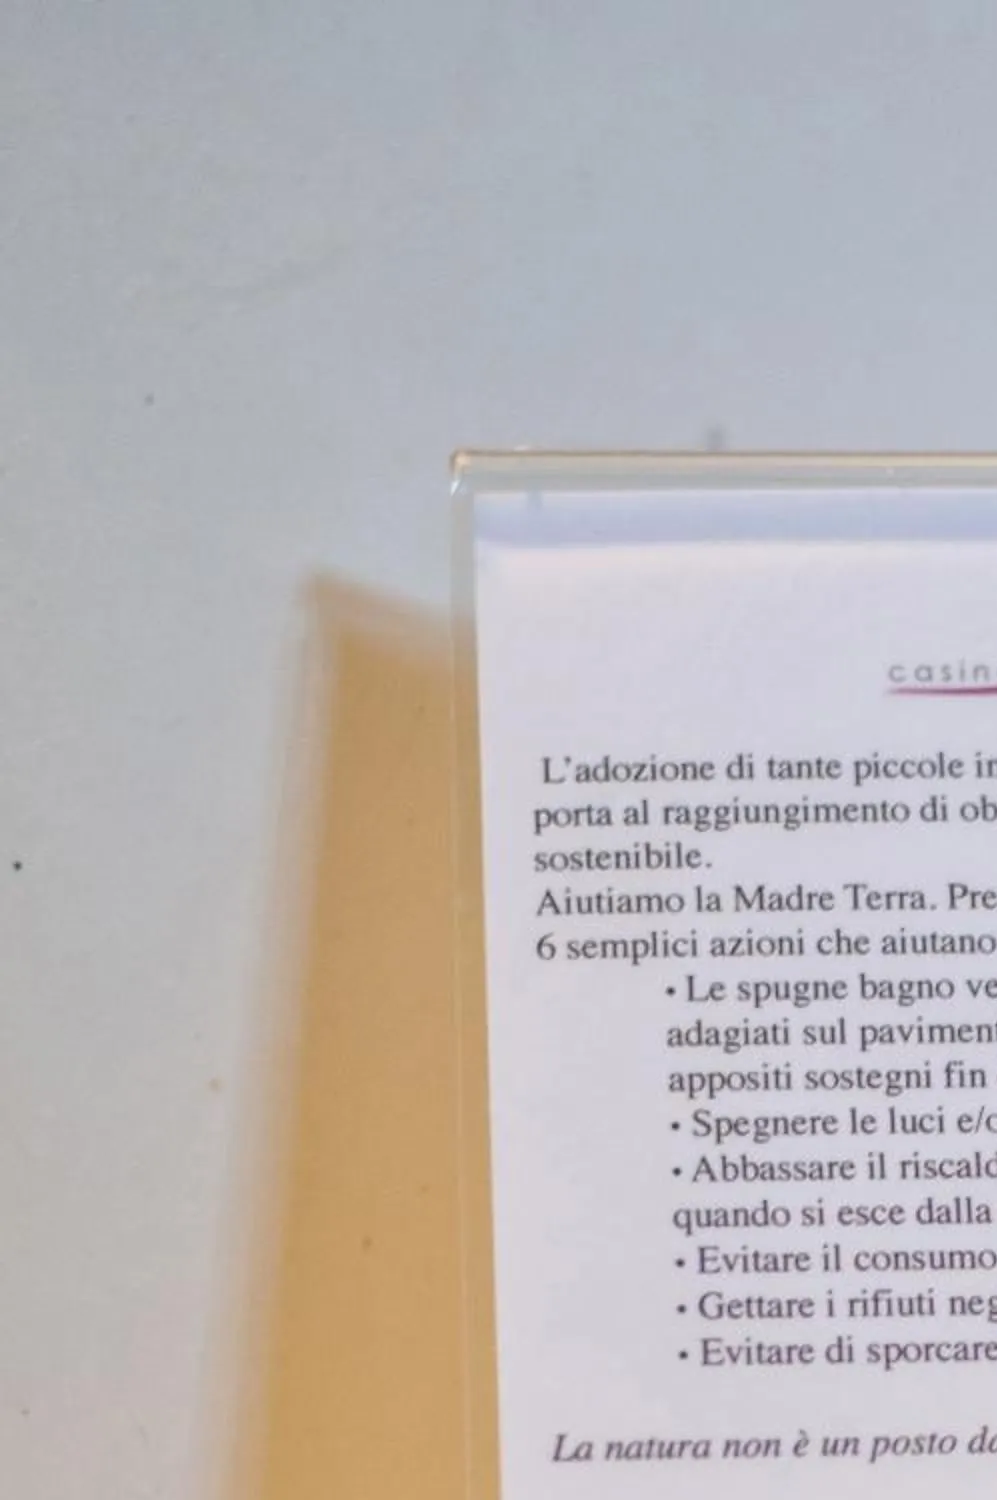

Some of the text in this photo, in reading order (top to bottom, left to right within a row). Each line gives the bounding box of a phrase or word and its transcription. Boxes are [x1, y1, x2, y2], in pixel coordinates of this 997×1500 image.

[541, 753, 716, 785] L'adozione
[724, 752, 756, 782] di
[765, 755, 843, 781] tante
[852, 750, 965, 788] piccole
[532, 803, 615, 837] porta
[621, 797, 650, 827] al
[661, 794, 912, 834] raggiungimento
[918, 793, 949, 824] di
[533, 842, 713, 873] sostenibile.
[535, 885, 686, 917] Aiutiamo
[732, 882, 836, 914] Madre
[841, 881, 938, 912] Terra.
[535, 932, 558, 961] 6
[565, 928, 699, 968] semplici
[708, 926, 806, 959] azioni
[815, 926, 871, 958] che
[684, 972, 727, 1004] Le
[736, 979, 849, 1010] spugne
[857, 970, 956, 1009] bagno
[666, 1016, 792, 1057] adagiati
[802, 1015, 848, 1046] sul
[667, 1060, 794, 1102] appositi
[803, 1059, 933, 1099] sostegni
[943, 1058, 988, 1091] fin
[690, 1105, 840, 1147] Spegnere
[887, 1104, 946, 1137] luci
[691, 1151, 857, 1185] Abbassare
[671, 1198, 792, 1238] quando
[835, 1203, 907, 1228] esce
[914, 1194, 994, 1226] dalla
[696, 1242, 812, 1276] Evitare
[697, 1288, 816, 1322] Gettare
[847, 1287, 937, 1319] rifiuti
[699, 1334, 816, 1368] Evitare
[824, 1334, 856, 1366] di
[551, 1432, 598, 1464] La
[603, 1437, 715, 1462] natura
[721, 1436, 785, 1459] non
[818, 1435, 864, 1458] un
[869, 1432, 960, 1465] posto
